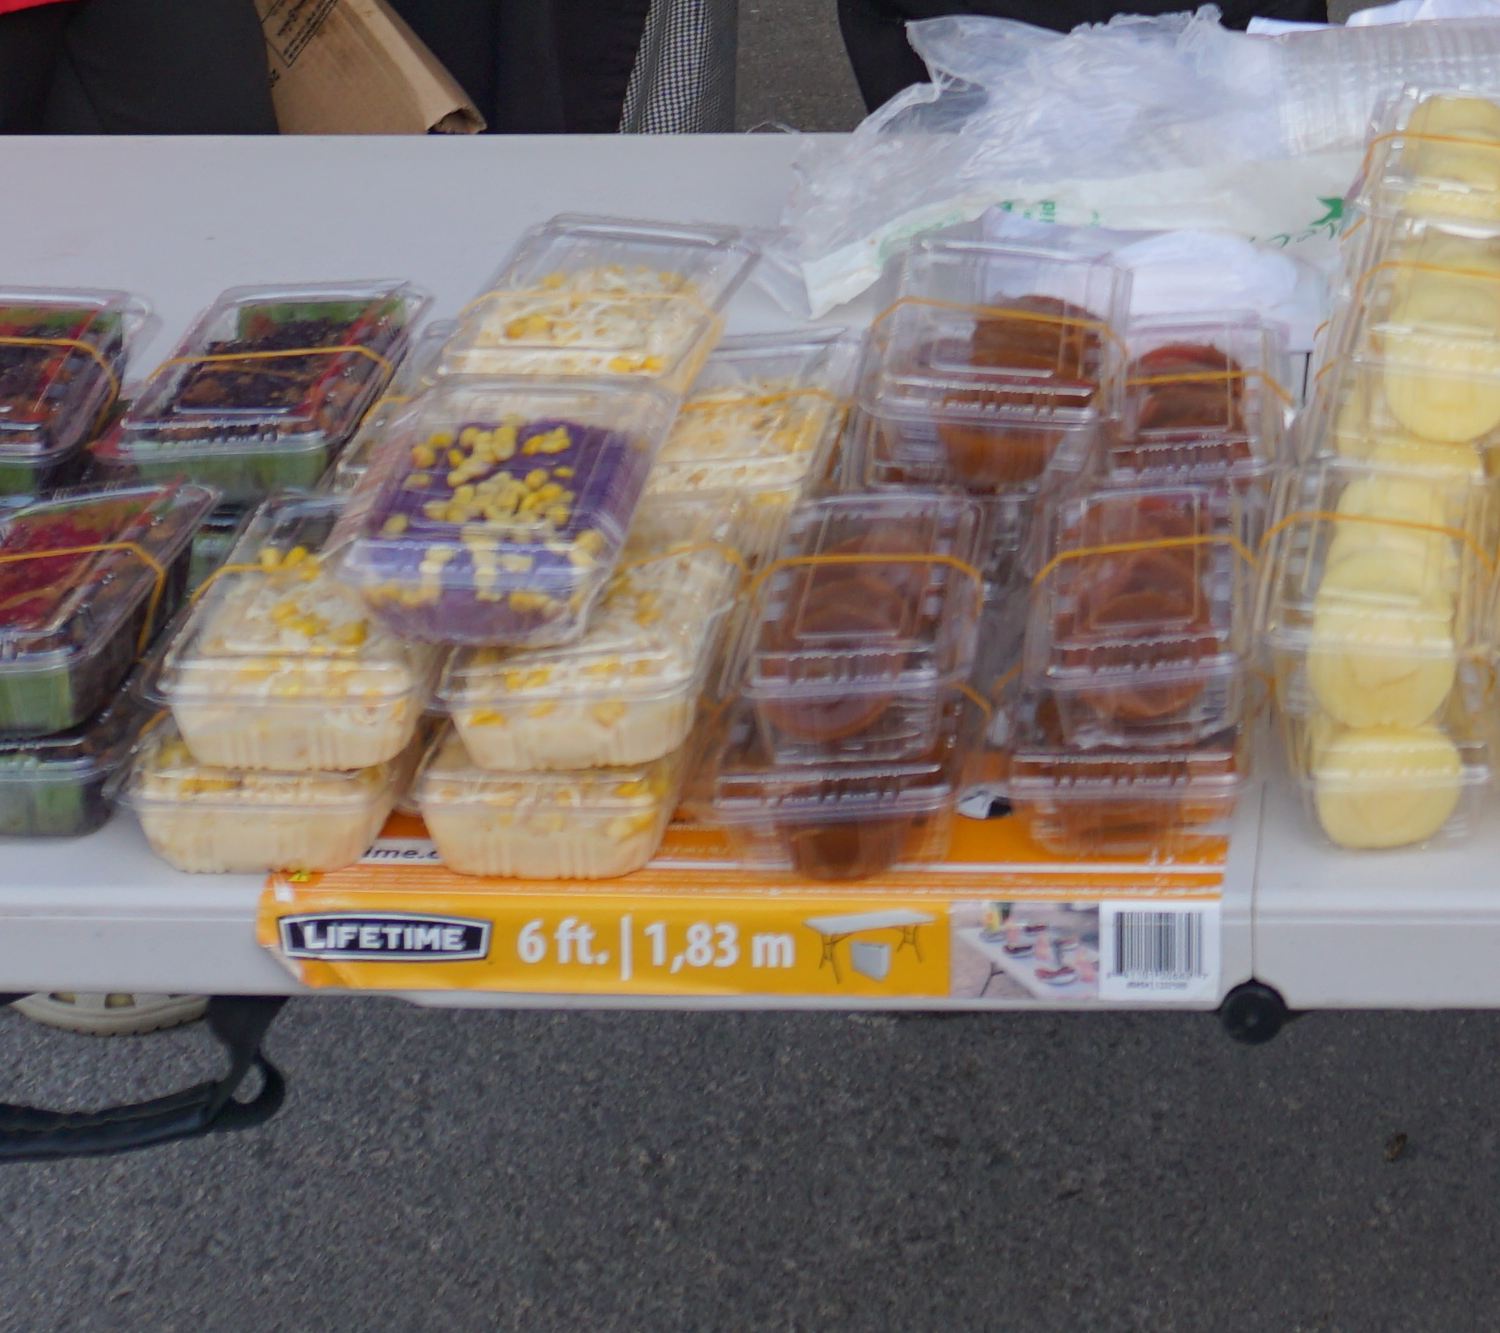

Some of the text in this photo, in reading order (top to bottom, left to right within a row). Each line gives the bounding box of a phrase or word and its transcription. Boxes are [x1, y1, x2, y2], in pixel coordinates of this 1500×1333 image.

[301, 921, 467, 951] LIFETIME
[517, 915, 795, 974] 6 ft. 1,83 m
